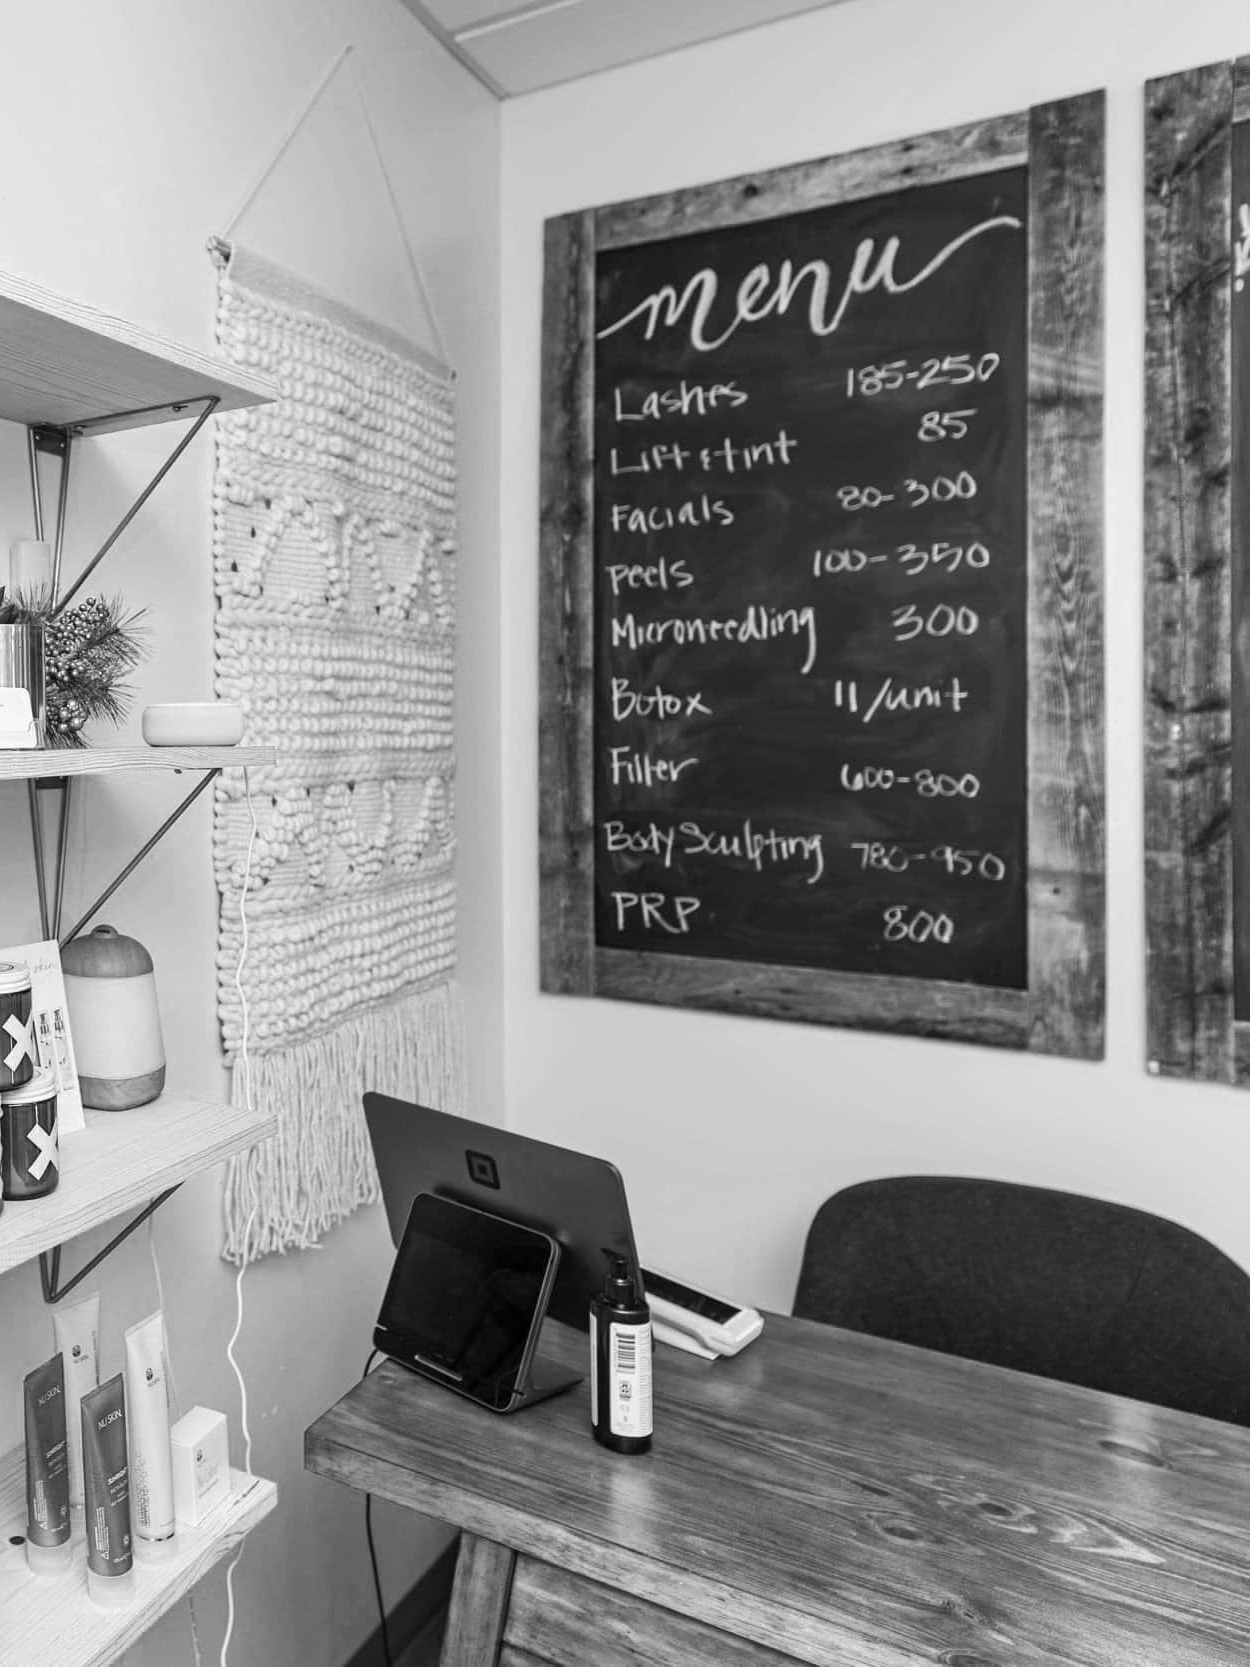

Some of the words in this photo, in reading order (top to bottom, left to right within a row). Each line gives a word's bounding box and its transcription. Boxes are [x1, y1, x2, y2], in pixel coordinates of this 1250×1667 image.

[846, 352, 1001, 398] 185-250
[613, 379, 749, 422] Lashes
[917, 408, 978, 442] 85
[714, 429, 798, 473] tint
[611, 494, 735, 534] Facials
[611, 605, 817, 675] Microneedling
[892, 603, 980, 642] 300
[611, 677, 713, 722] Botox
[610, 745, 699, 788] Filler
[840, 763, 981, 800] 600-800
[610, 891, 702, 934] PRP
[883, 905, 955, 944] 800
